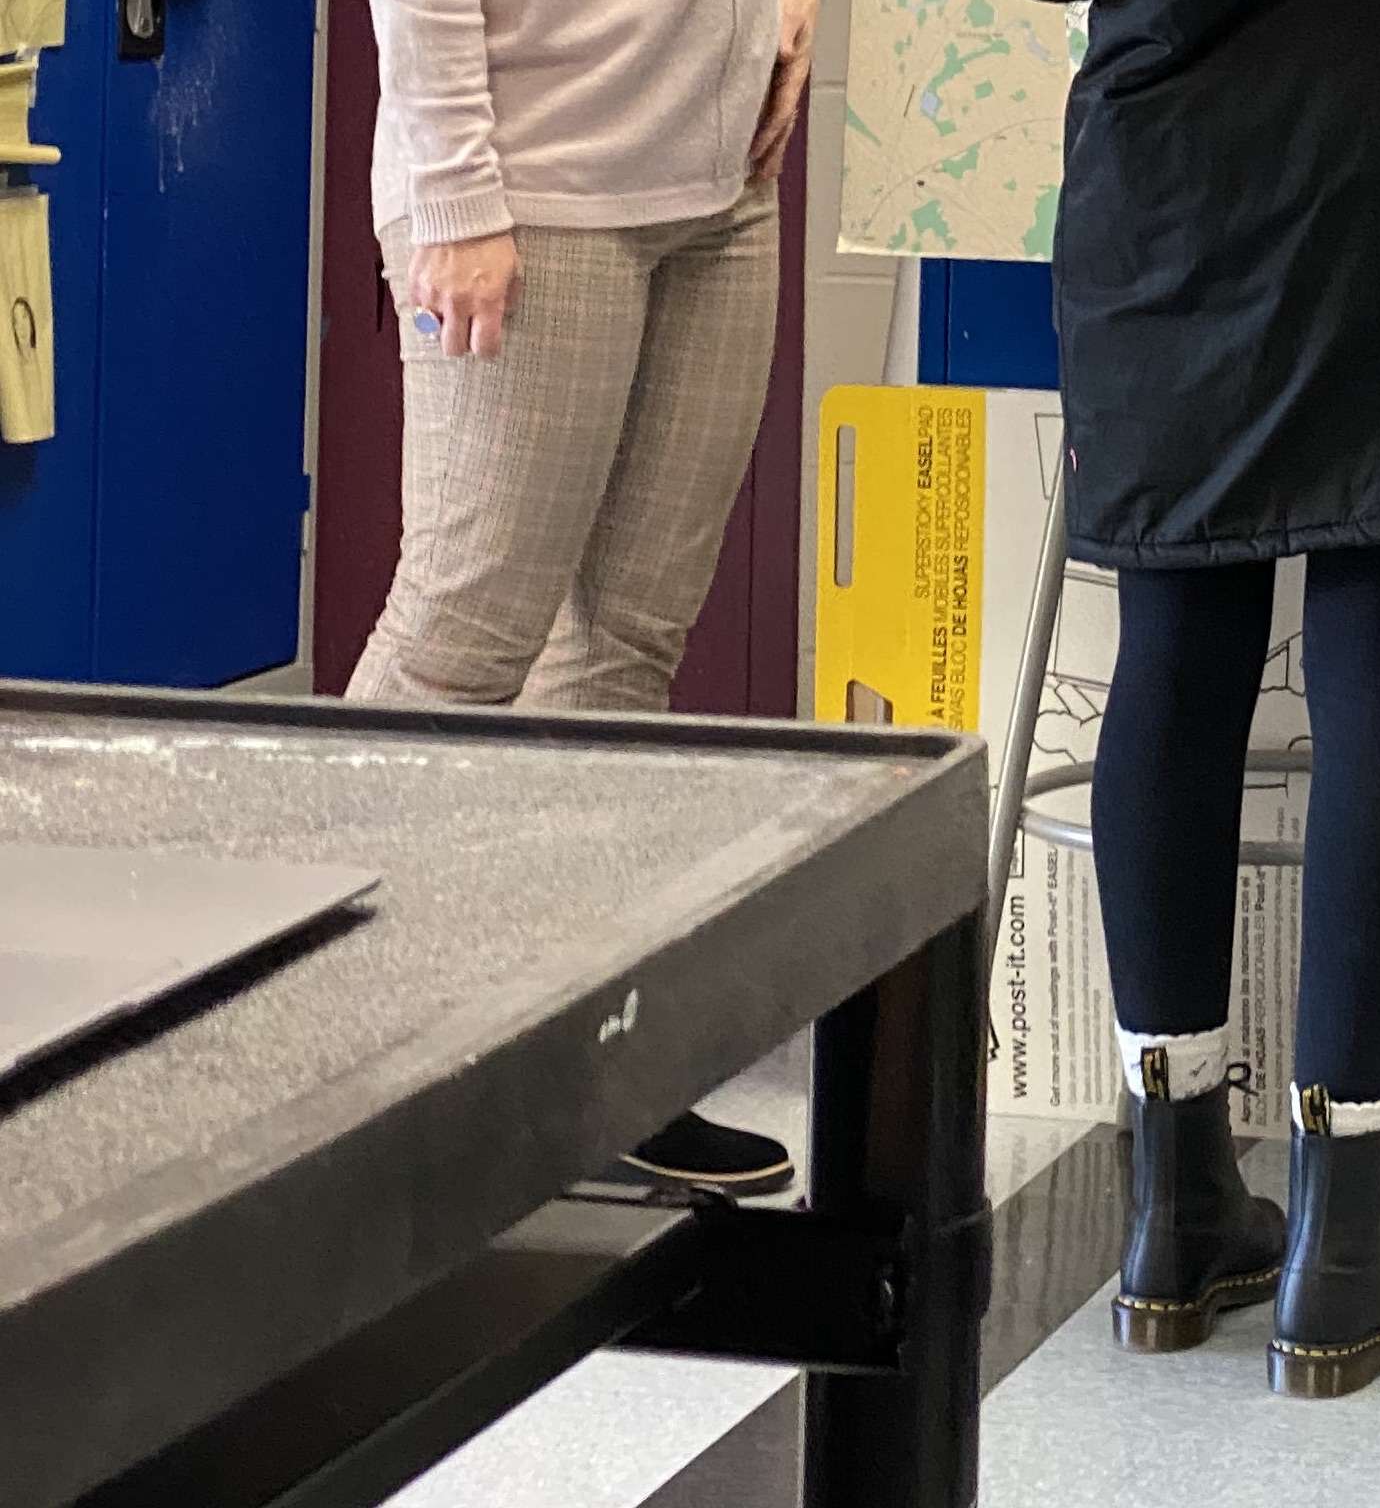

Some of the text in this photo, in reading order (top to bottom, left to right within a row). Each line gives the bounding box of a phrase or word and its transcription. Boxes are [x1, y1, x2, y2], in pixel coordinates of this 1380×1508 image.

[953, 555, 969, 610] HOJAS
[952, 613, 967, 637] DE
[1006, 895, 1031, 1100] www.post-it.com
